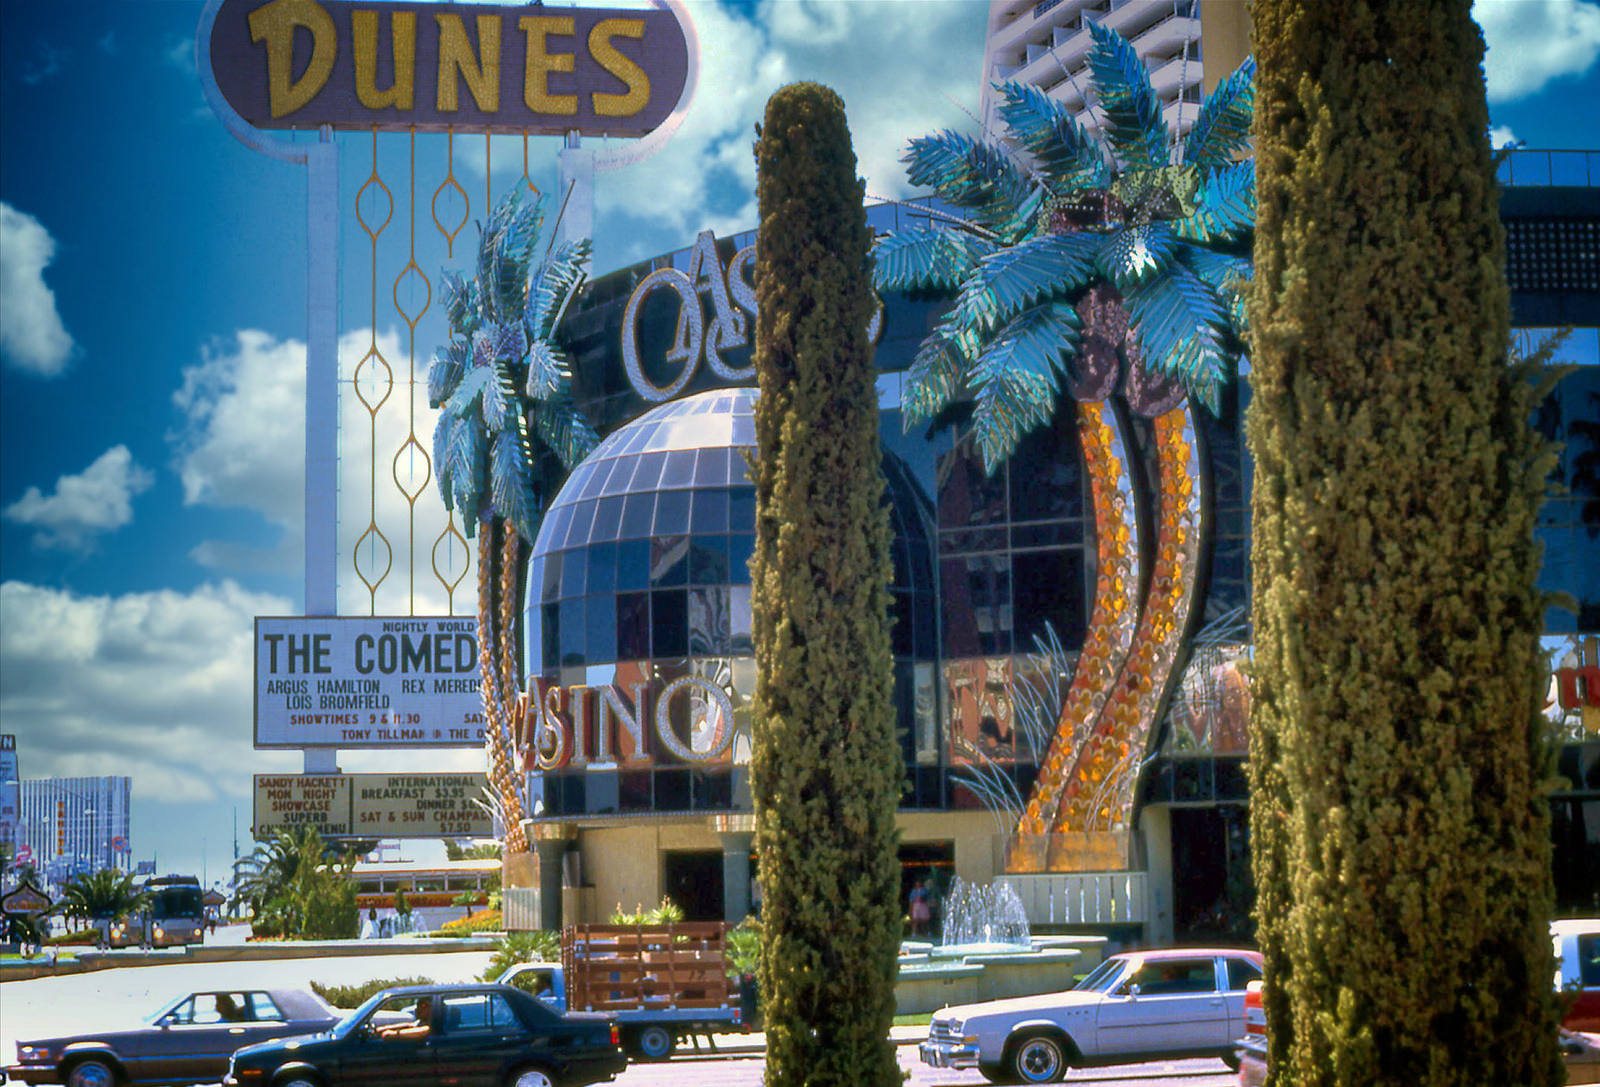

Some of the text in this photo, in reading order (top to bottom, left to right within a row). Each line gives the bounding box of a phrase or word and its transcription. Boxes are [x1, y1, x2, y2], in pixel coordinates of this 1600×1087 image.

[248, 0, 651, 119] DUNES
[383, 622, 475, 632] NIGHTLY WORLD
[264, 634, 478, 674] THE COMED
[267, 680, 308, 693] ARGUS
[317, 679, 380, 693] HAMILTON
[402, 679, 425, 693] REX
[287, 695, 390, 709] LOIS BROMFIELD
[290, 714, 359, 725] SHOWTIMES
[369, 714, 376, 724] 9
[342, 729, 371, 740] TONY
[450, 729, 470, 739] THE
[259, 776, 346, 788] SANDY HACKETT
[388, 777, 475, 787] INTERNATIONAL
[267, 789, 336, 799] MON NIGHT
[361, 788, 425, 799] BREAKFAST
[273, 800, 331, 811] SHOWCASE
[417, 800, 455, 810] DINNER
[284, 812, 328, 822] SUPERB
[360, 812, 381, 823] SAT
[402, 811, 425, 822] SUN
